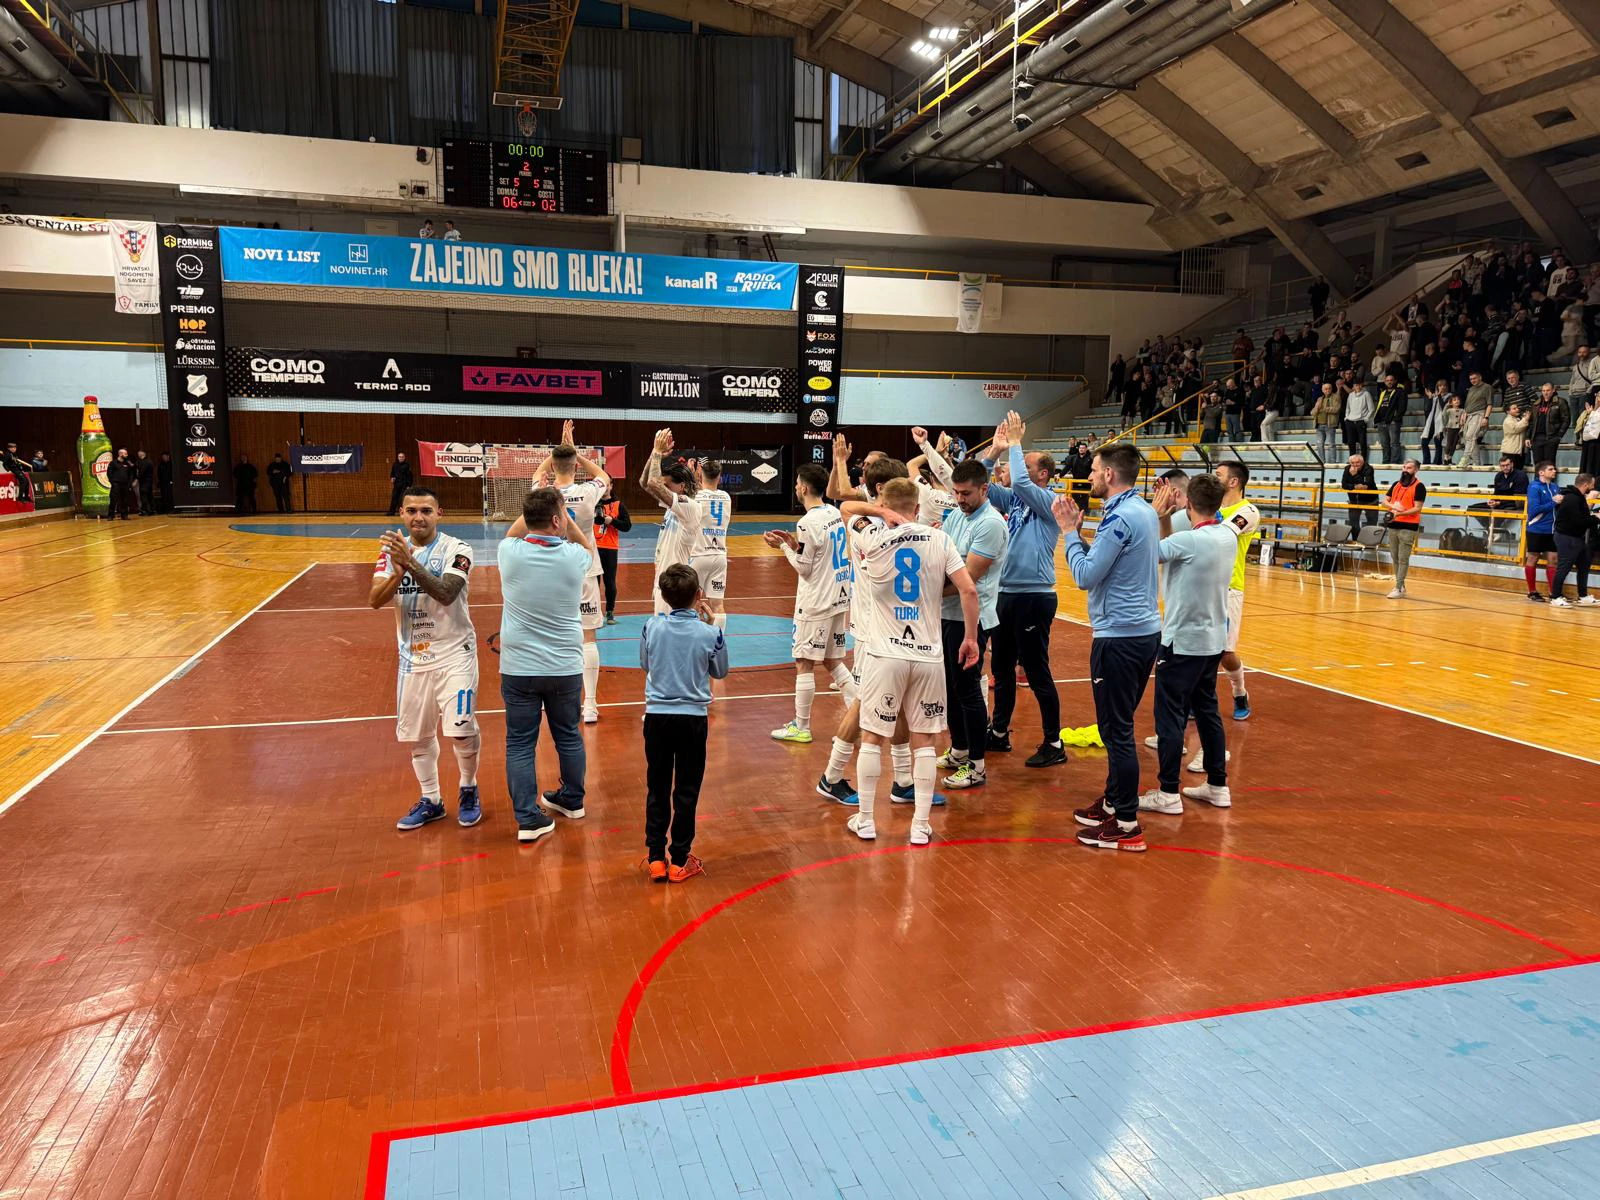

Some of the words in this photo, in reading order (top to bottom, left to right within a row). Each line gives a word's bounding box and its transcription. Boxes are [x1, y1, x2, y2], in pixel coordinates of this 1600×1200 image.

[508, 143, 544, 158] 00:00
[523, 161, 530, 171] 2
[499, 177, 509, 186] SET
[513, 177, 520, 187] 5
[533, 178, 540, 189] 5
[502, 196, 518, 208] 06
[541, 199, 557, 211] 02
[25, 218, 83, 232] CENTAR
[176, 237, 214, 247] FORMING
[243, 247, 283, 261] NOVI
[287, 250, 321, 263] LIST
[329, 265, 389, 276] NOVINET.HR
[409, 242, 504, 288] ZAJEDNO
[512, 249, 560, 290] SMO
[567, 252, 644, 296] RIJEKA!
[733, 271, 776, 284] RADIO
[816, 272, 839, 283] FOUR
[741, 280, 782, 293] RIJEKA
[170, 304, 216, 315] PREMIO
[179, 318, 207, 331] HOP
[817, 347, 836, 355] SPORT
[176, 354, 216, 366] LÜRSSEN
[250, 357, 326, 374] COMO
[808, 359, 833, 367] POWER
[251, 372, 326, 384] TEMPERA
[495, 373, 596, 389] FAVBET
[722, 375, 781, 389] COMO
[354, 382, 398, 391] TERMO
[722, 387, 780, 398] TEMPERA
[983, 383, 1020, 391] ZABRANJENO
[710, 500, 723, 526] 4
[890, 534, 931, 545] FAVBET
[830, 526, 849, 570] 12
[894, 547, 921, 602] 8
[894, 606, 919, 621] TURK
[457, 688, 473, 715] 11
